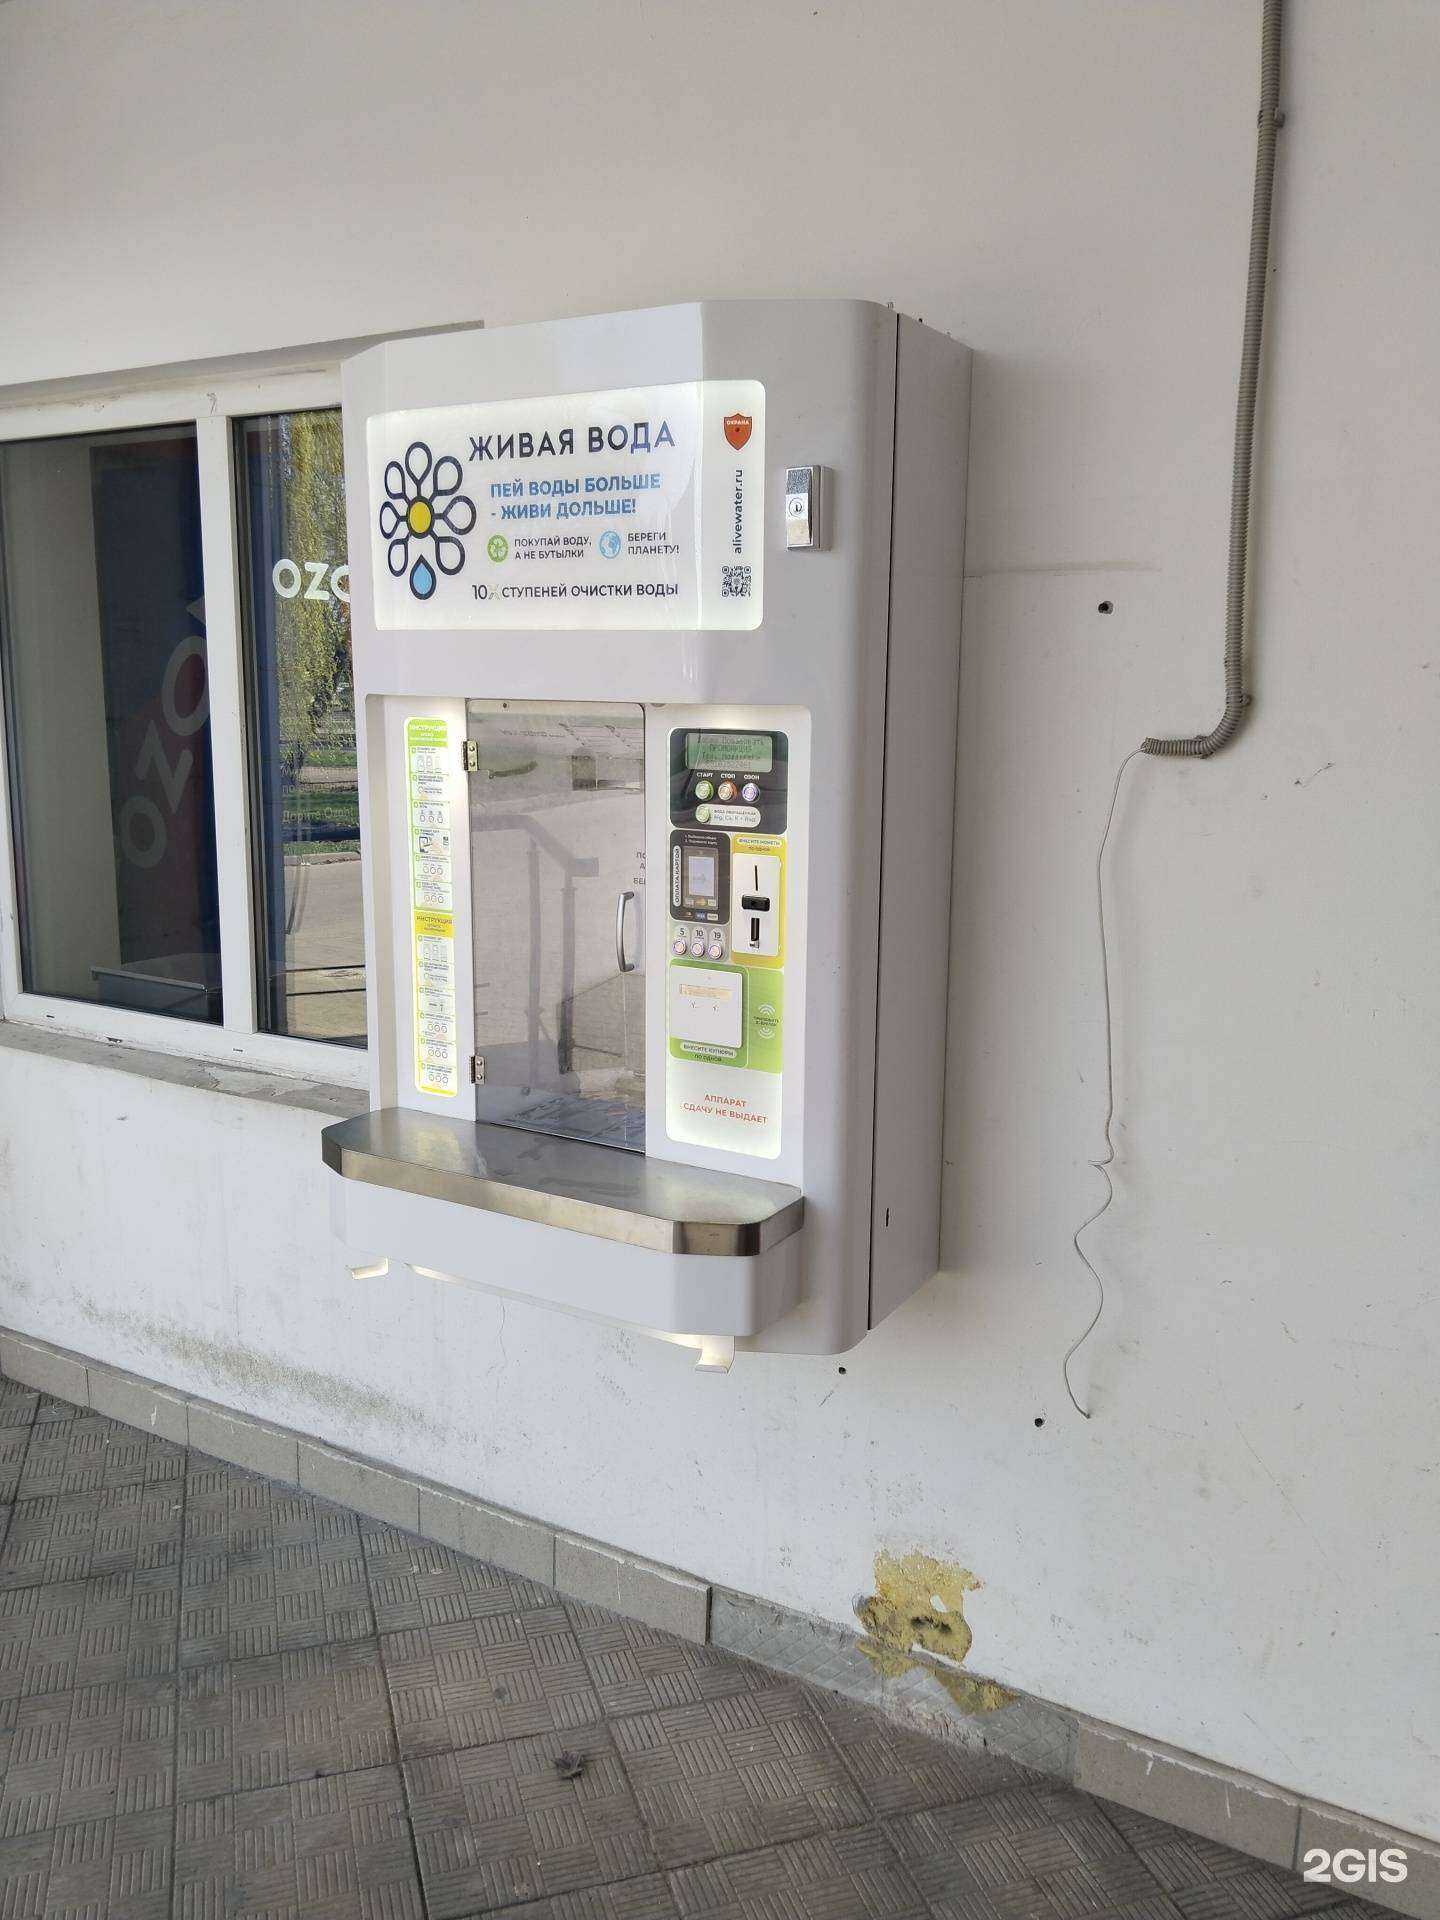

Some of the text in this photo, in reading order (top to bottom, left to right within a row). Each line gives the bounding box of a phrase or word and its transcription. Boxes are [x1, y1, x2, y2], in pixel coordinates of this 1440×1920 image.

[469, 420, 676, 462] ЖИВАЯ ВОДА
[490, 473, 661, 498] ПЕЙ ВОДЫ БОЛЬШЕ
[501, 503, 551, 520] ЖИВИ
[556, 498, 636, 520] ДОЛЬШЕ!
[732, 469, 744, 554] alivewater.ru
[514, 535, 592, 548] ПОКУПАЙ ВОДУ,
[627, 531, 666, 542] БЕРЕГИ
[514, 549, 585, 560] А НЕ БУТЫЛКИ
[627, 544, 680, 556] ПЛАНЕТУ!
[272, 558, 351, 604] OZO
[501, 583, 568, 599] СТУПЕНЕЙ
[571, 584, 633, 598] ОЧИСТКИ
[636, 583, 679, 598] ВОДЫ
[679, 928, 685, 936] 5
[695, 929, 704, 937] 10
[704, 1094, 747, 1108] АППАРАТ
[683, 1102, 768, 1124] СДАЧУ НЕ ВЫДАЕТ
